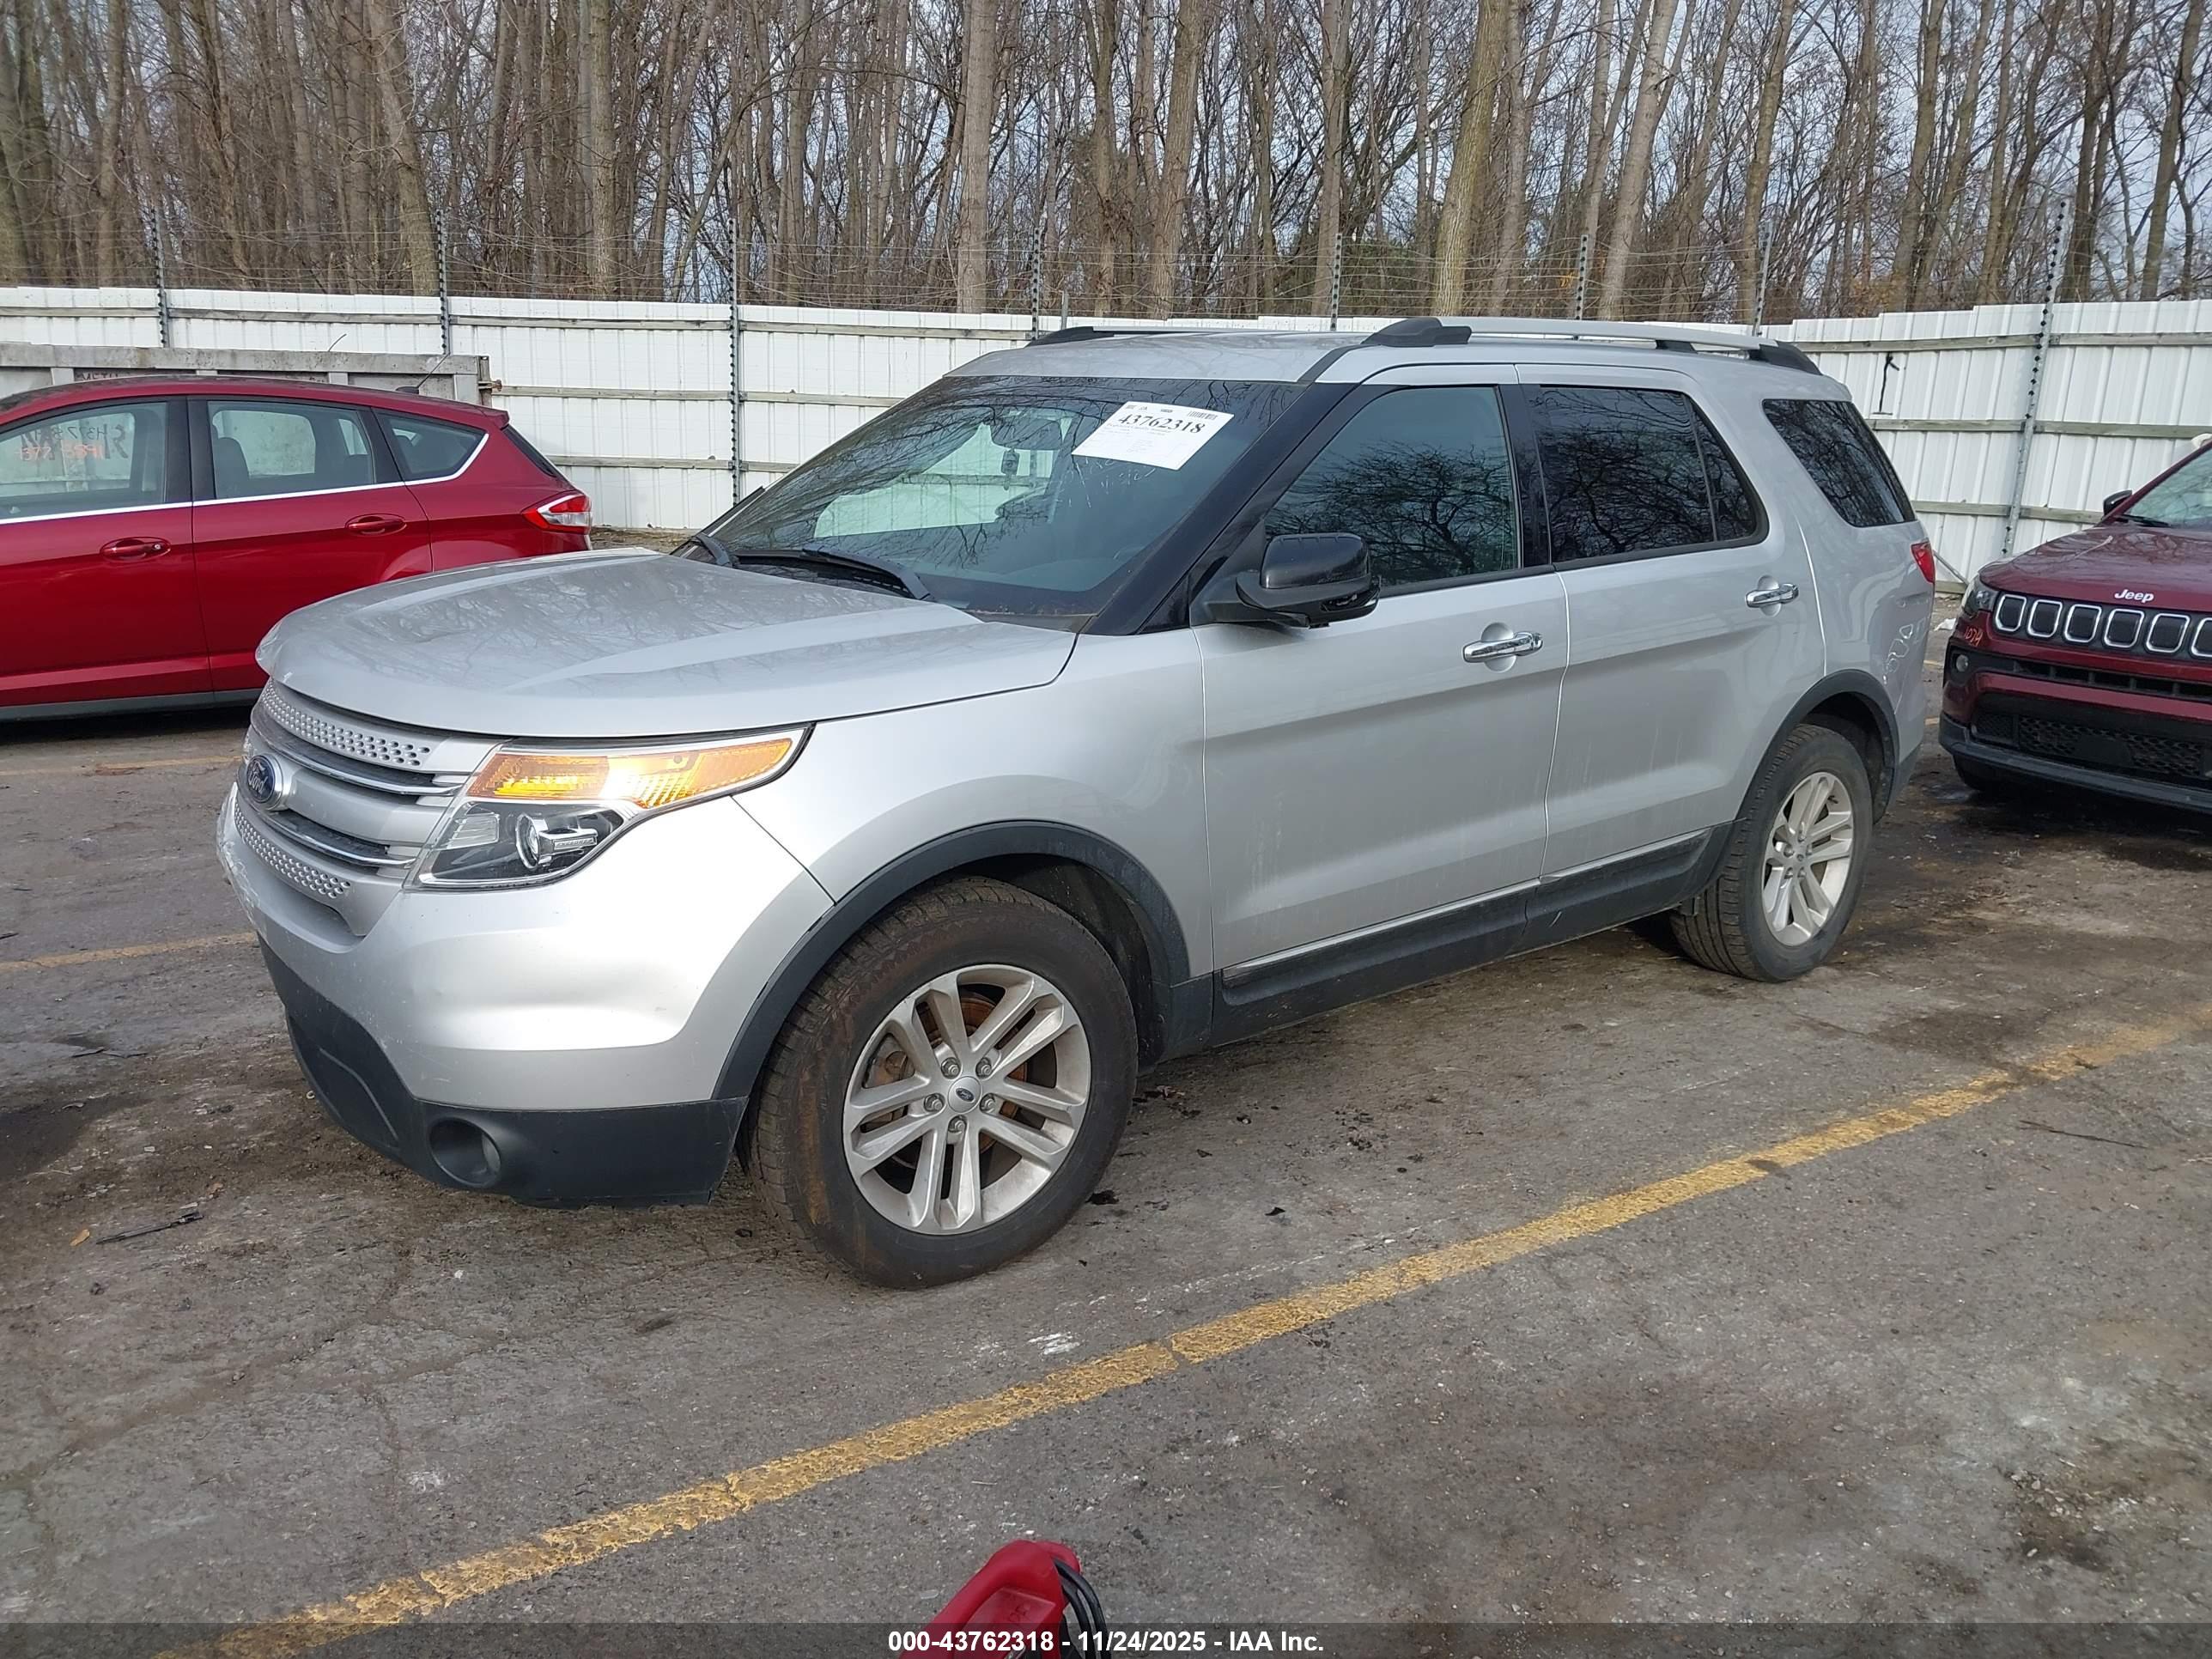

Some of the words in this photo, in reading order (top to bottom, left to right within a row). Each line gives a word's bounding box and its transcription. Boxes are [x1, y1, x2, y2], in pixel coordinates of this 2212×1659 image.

[1117, 413, 1206, 434] 43762318
[2114, 588, 2154, 604] Jeep
[247, 759, 269, 795] Ford
